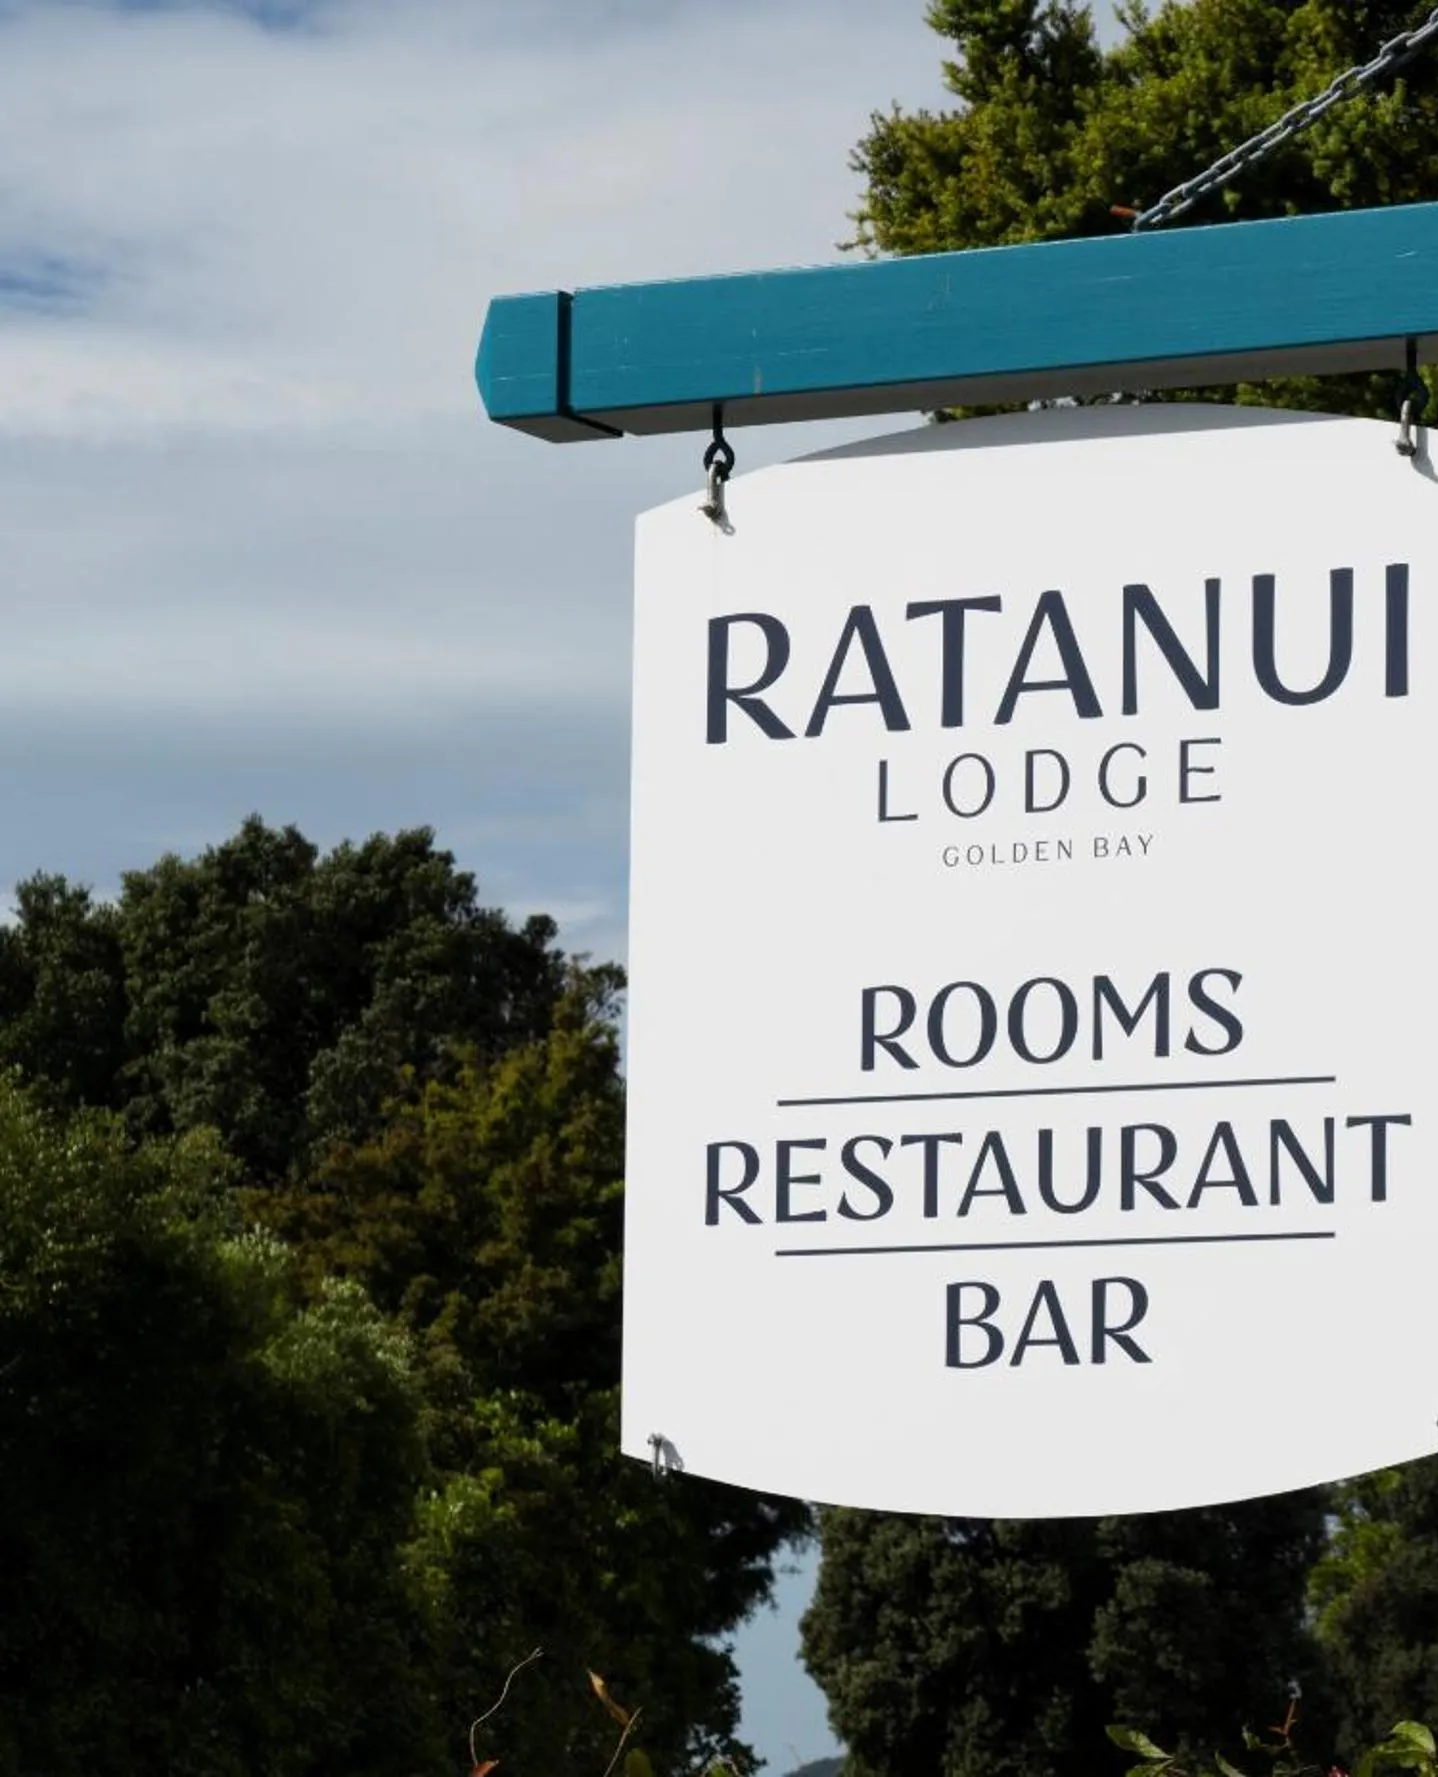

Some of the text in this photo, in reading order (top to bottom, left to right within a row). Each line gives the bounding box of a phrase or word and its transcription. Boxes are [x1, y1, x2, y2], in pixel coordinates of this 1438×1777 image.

[706, 563, 1410, 745] RATANUI
[877, 737, 1222, 823] LODGE
[942, 834, 1155, 868] GOLDEN BAY
[861, 968, 1243, 1071] ROOMS
[705, 1114, 1411, 1226] RESTAURANT
[945, 1277, 1152, 1369] BAR
